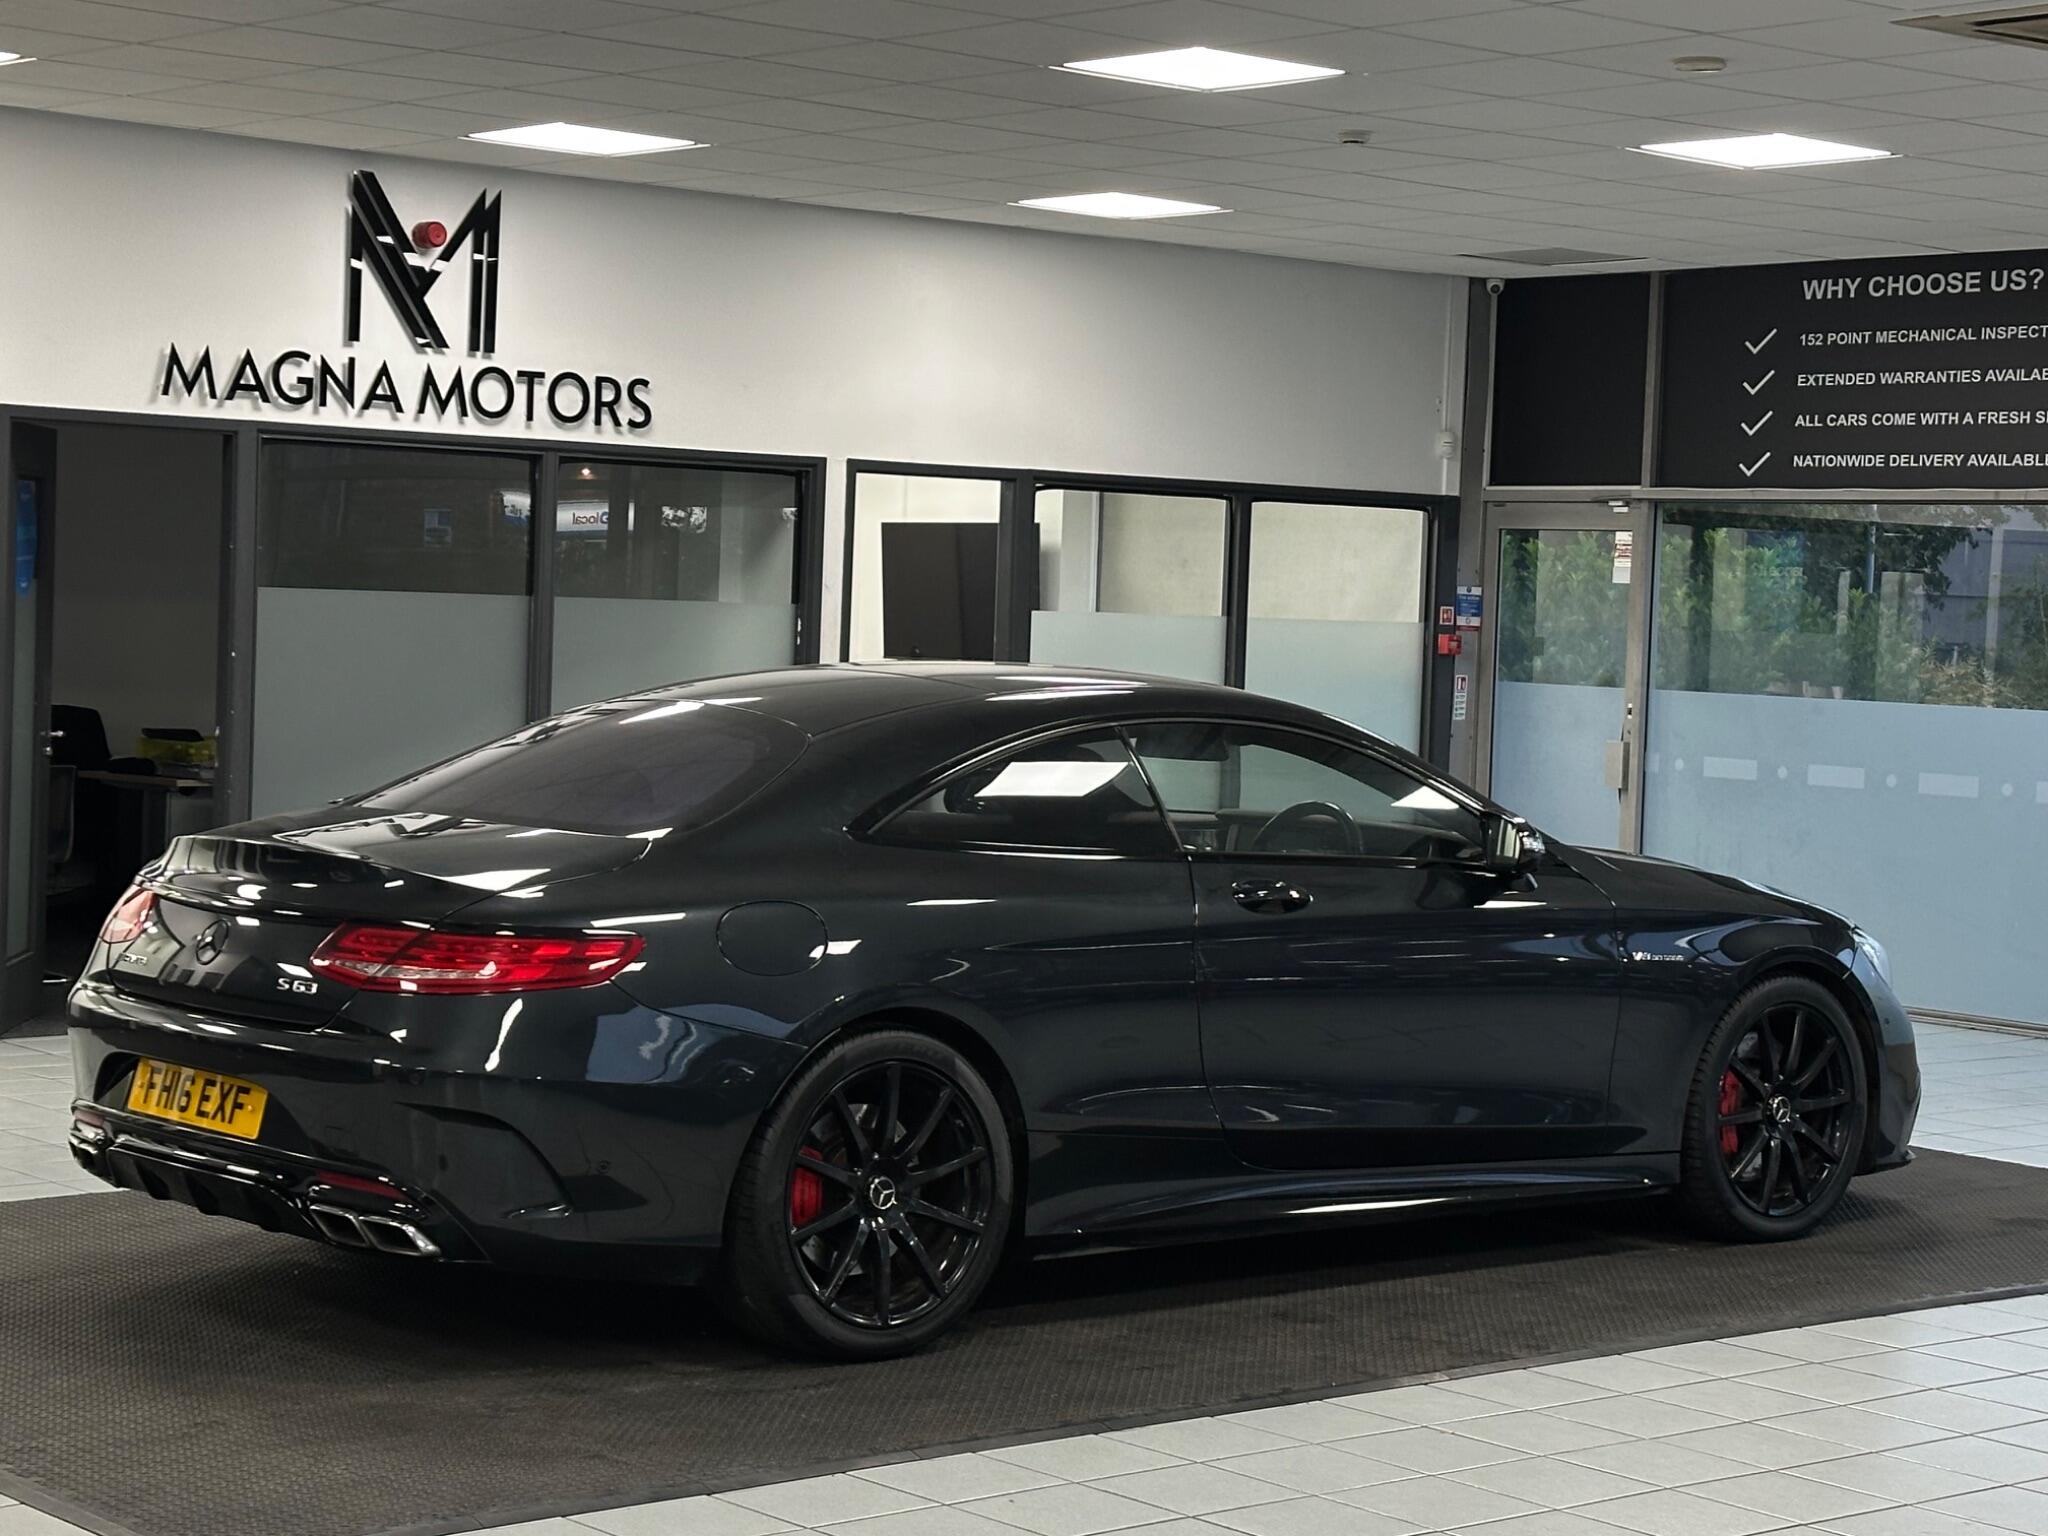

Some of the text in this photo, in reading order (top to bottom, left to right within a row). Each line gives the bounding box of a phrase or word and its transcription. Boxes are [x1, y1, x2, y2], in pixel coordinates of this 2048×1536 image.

[1802, 268, 2045, 300] WHY CHOOSE US?
[1799, 333, 1824, 346] 152
[1827, 331, 1873, 346] POINT
[1875, 327, 1977, 344] MECHANICAL
[161, 342, 652, 429] MAGNA MOTORS
[1796, 372, 1876, 387] EXTENDED
[1879, 369, 1982, 385] WARRANTIES
[1794, 410, 2048, 428] ALL CARS COME WITH A FRESH S
[1793, 454, 1885, 468] NATIONWIDE
[1888, 453, 1965, 468] DELIVERY
[196, 1078, 251, 1125] EXF
